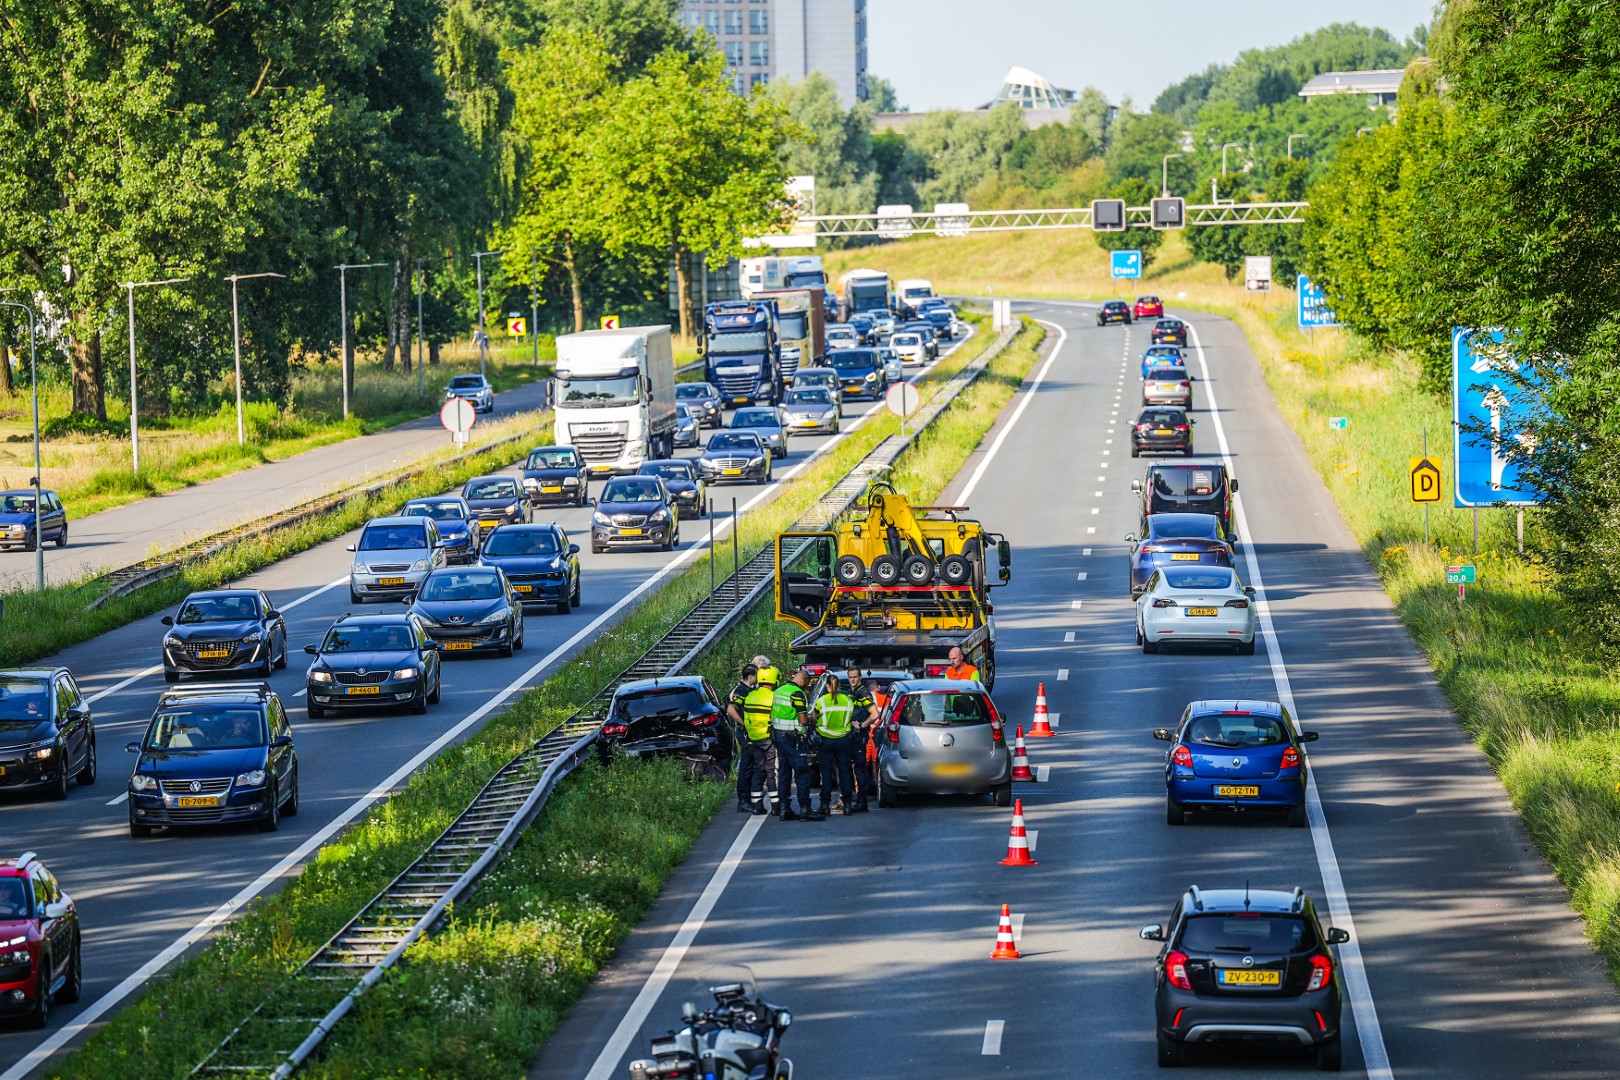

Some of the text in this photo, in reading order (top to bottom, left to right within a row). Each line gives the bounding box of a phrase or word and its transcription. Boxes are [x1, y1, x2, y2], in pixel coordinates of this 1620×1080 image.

[1421, 474, 1432, 491] D
[1220, 787, 1255, 795] 60-TZ-TN
[180, 797, 215, 806] TD-709-G
[1228, 971, 1275, 982] ZV-230-P
